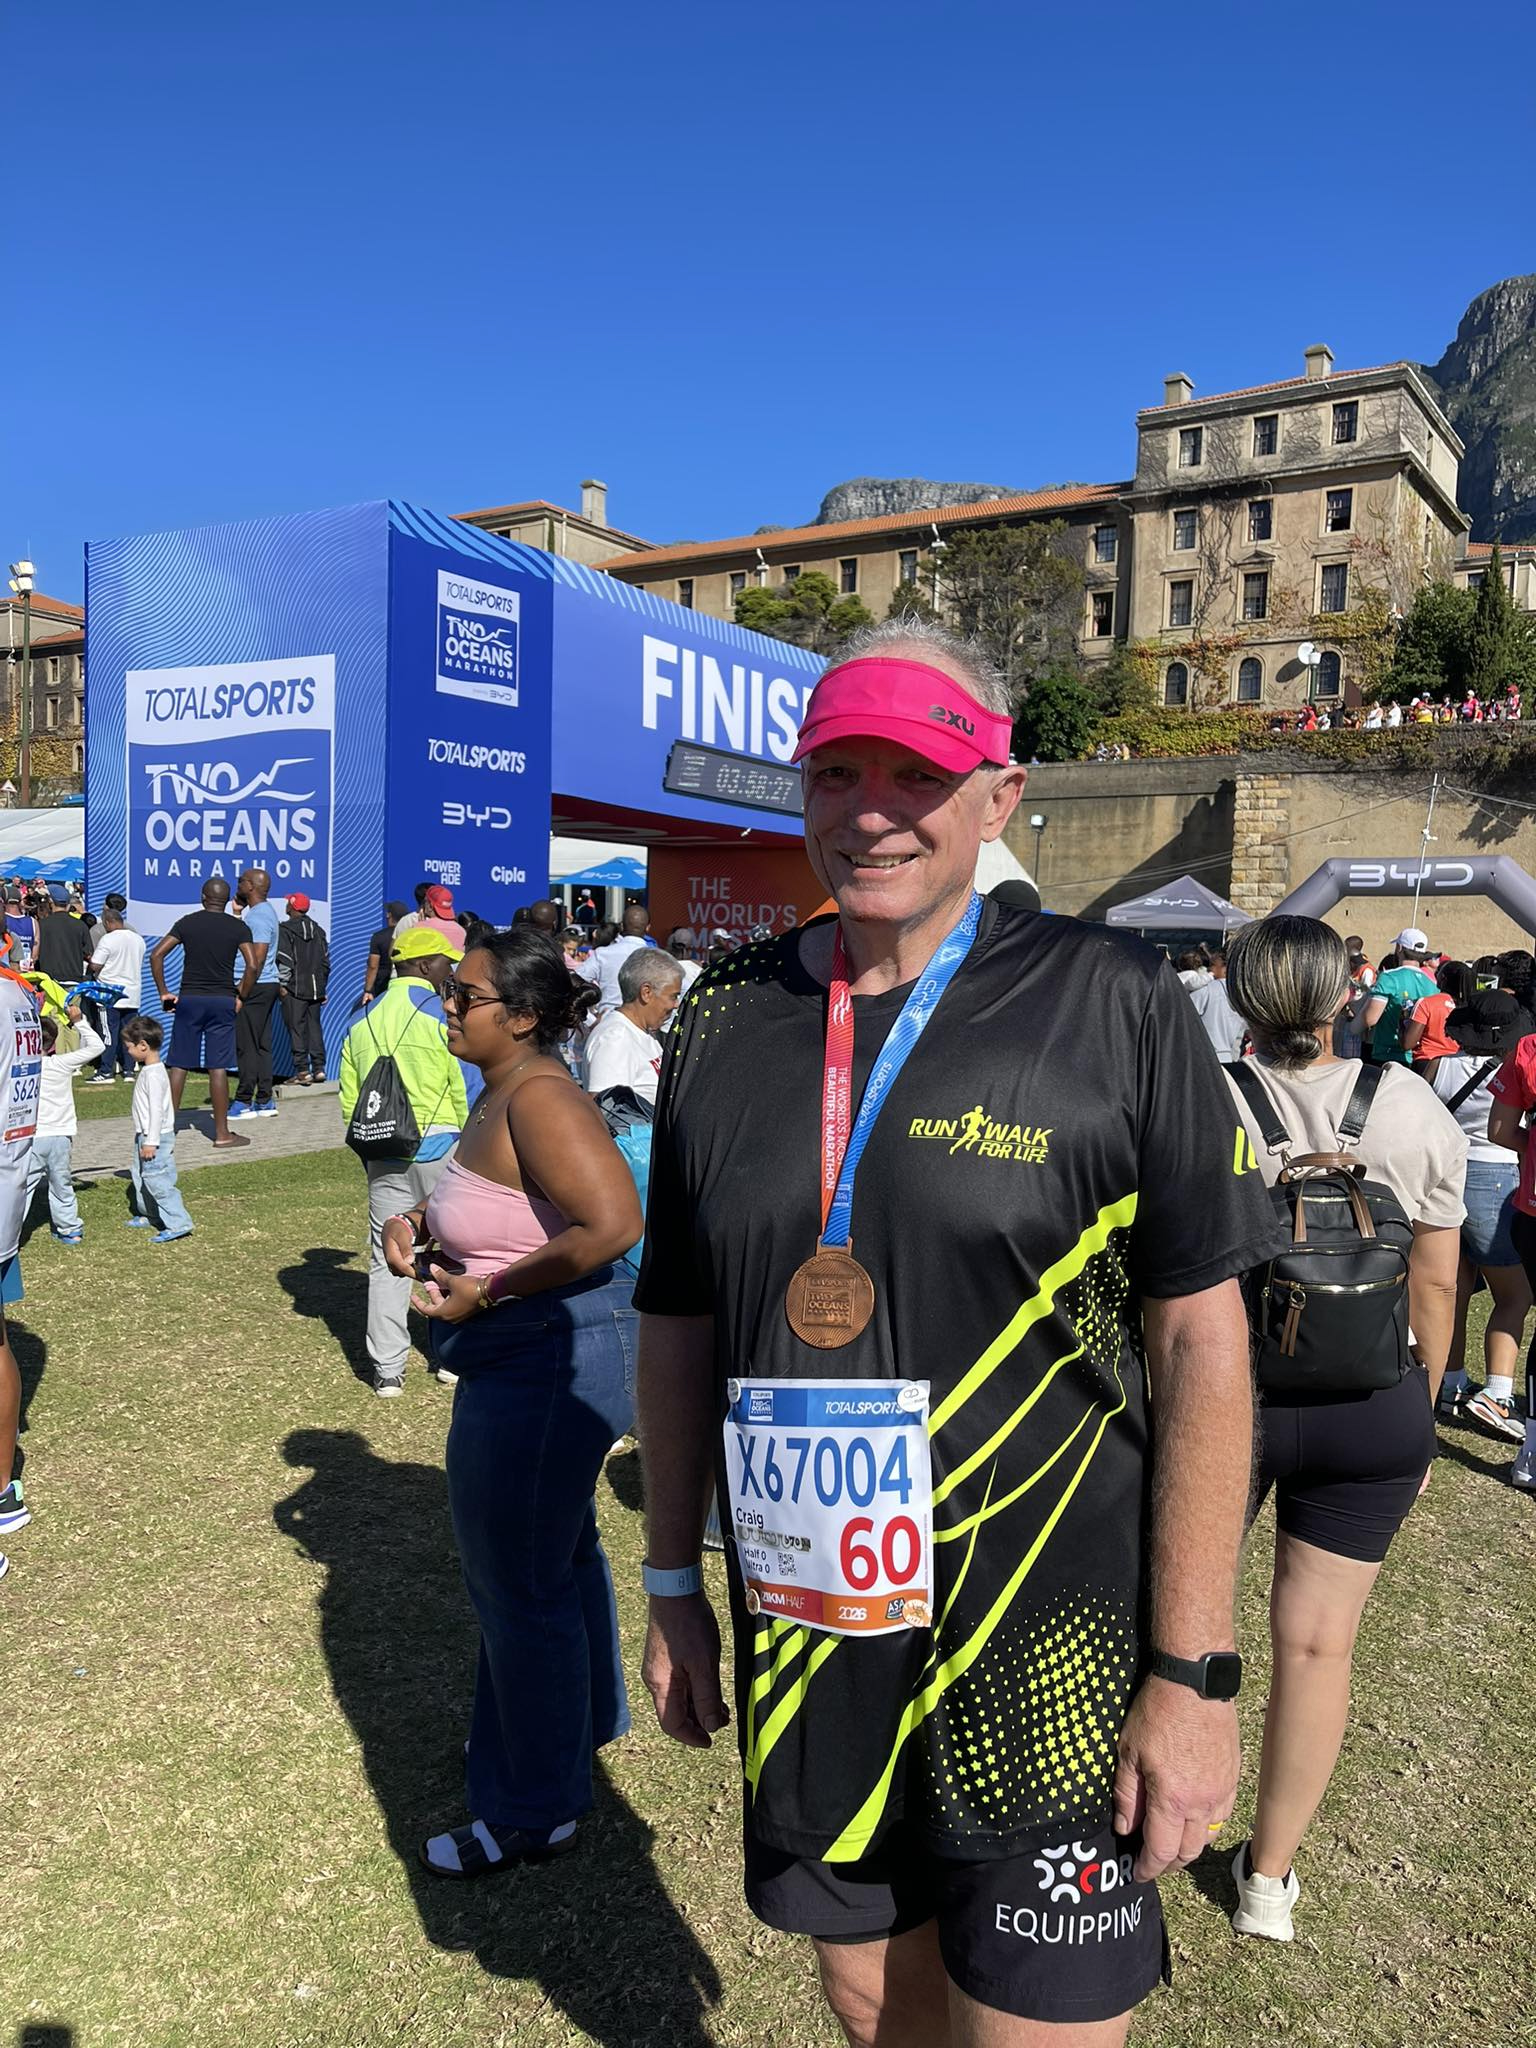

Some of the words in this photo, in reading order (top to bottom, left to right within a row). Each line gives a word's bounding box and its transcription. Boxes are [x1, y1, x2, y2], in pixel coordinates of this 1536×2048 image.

[446, 581, 513, 613] TOTALSPORTS
[446, 614, 486, 640] TWO
[445, 636, 513, 669] OCEANS
[444, 657, 513, 680] MARATHON
[145, 677, 316, 722] TOTALSPORTS
[928, 704, 975, 736] 2XU
[428, 738, 526, 774] TOTALSPORTS
[145, 762, 240, 804] TWO
[442, 801, 512, 829] BYD
[145, 808, 317, 852] OCEANS
[144, 858, 315, 878] MARATHON
[424, 859, 461, 873] POWER
[491, 866, 526, 886] Cipla
[1349, 863, 1474, 887] BYD
[440, 872, 461, 886] ADE
[688, 877, 731, 899] THE
[688, 903, 797, 927] WORLD'S
[839, 1067, 848, 1084] THE
[826, 1067, 837, 1122] BEAUTIFUL
[909, 1118, 958, 1137] RUN
[984, 1122, 1054, 1147] WALK
[825, 1124, 836, 1190] MARATHON
[977, 1141, 1013, 1159] FOR
[1013, 1147, 1049, 1164] LIFE
[809, 1300, 850, 1310] OCEANS
[736, 1433, 913, 1507] X67004
[736, 1507, 764, 1528] Craig
[744, 1549, 760, 1559] Half
[839, 1515, 921, 1591] 60
[785, 1595, 806, 1609] HALF
[838, 1607, 867, 1620] 2026
[888, 1599, 905, 1612] ASA
[995, 1896, 1144, 1944] EQUIPPING
